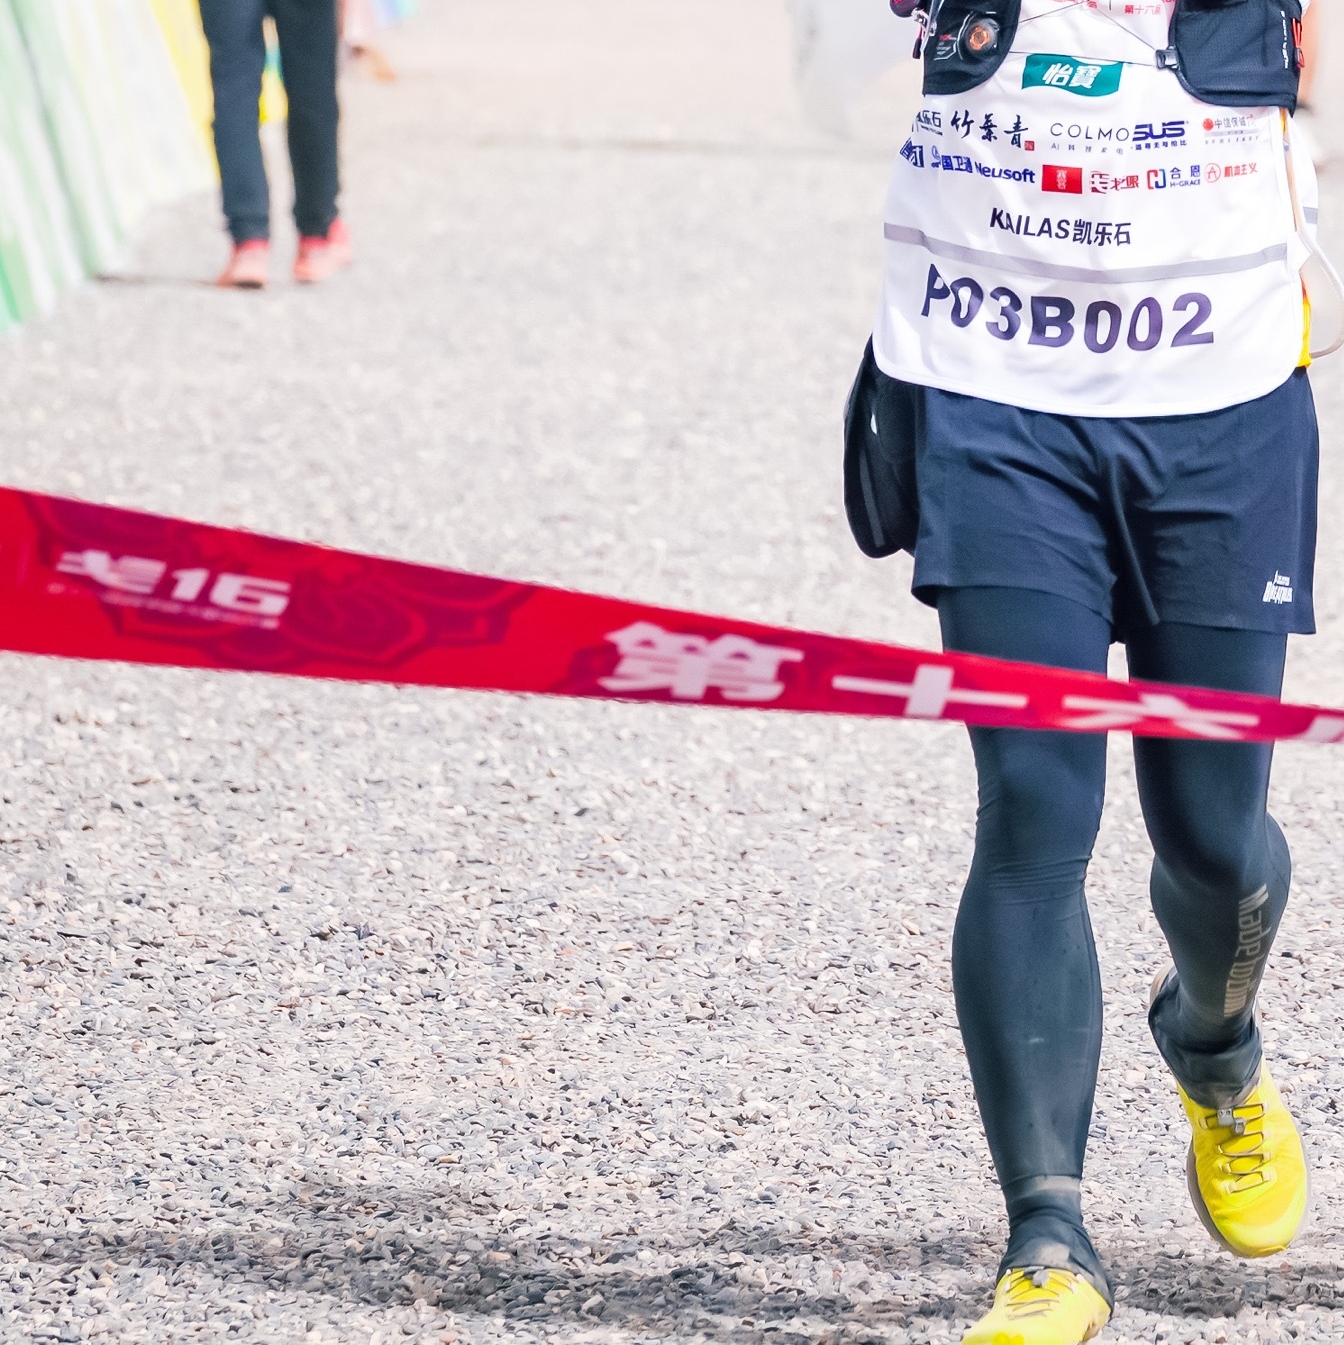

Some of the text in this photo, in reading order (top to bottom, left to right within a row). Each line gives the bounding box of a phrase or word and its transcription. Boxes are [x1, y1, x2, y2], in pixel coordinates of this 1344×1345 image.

[1042, 63, 1102, 89] 怡寶
[1050, 122, 1130, 143] COLMO
[1132, 120, 1185, 142] SUS
[974, 161, 1036, 184] Neusoft
[920, 263, 1215, 354] P03B002
